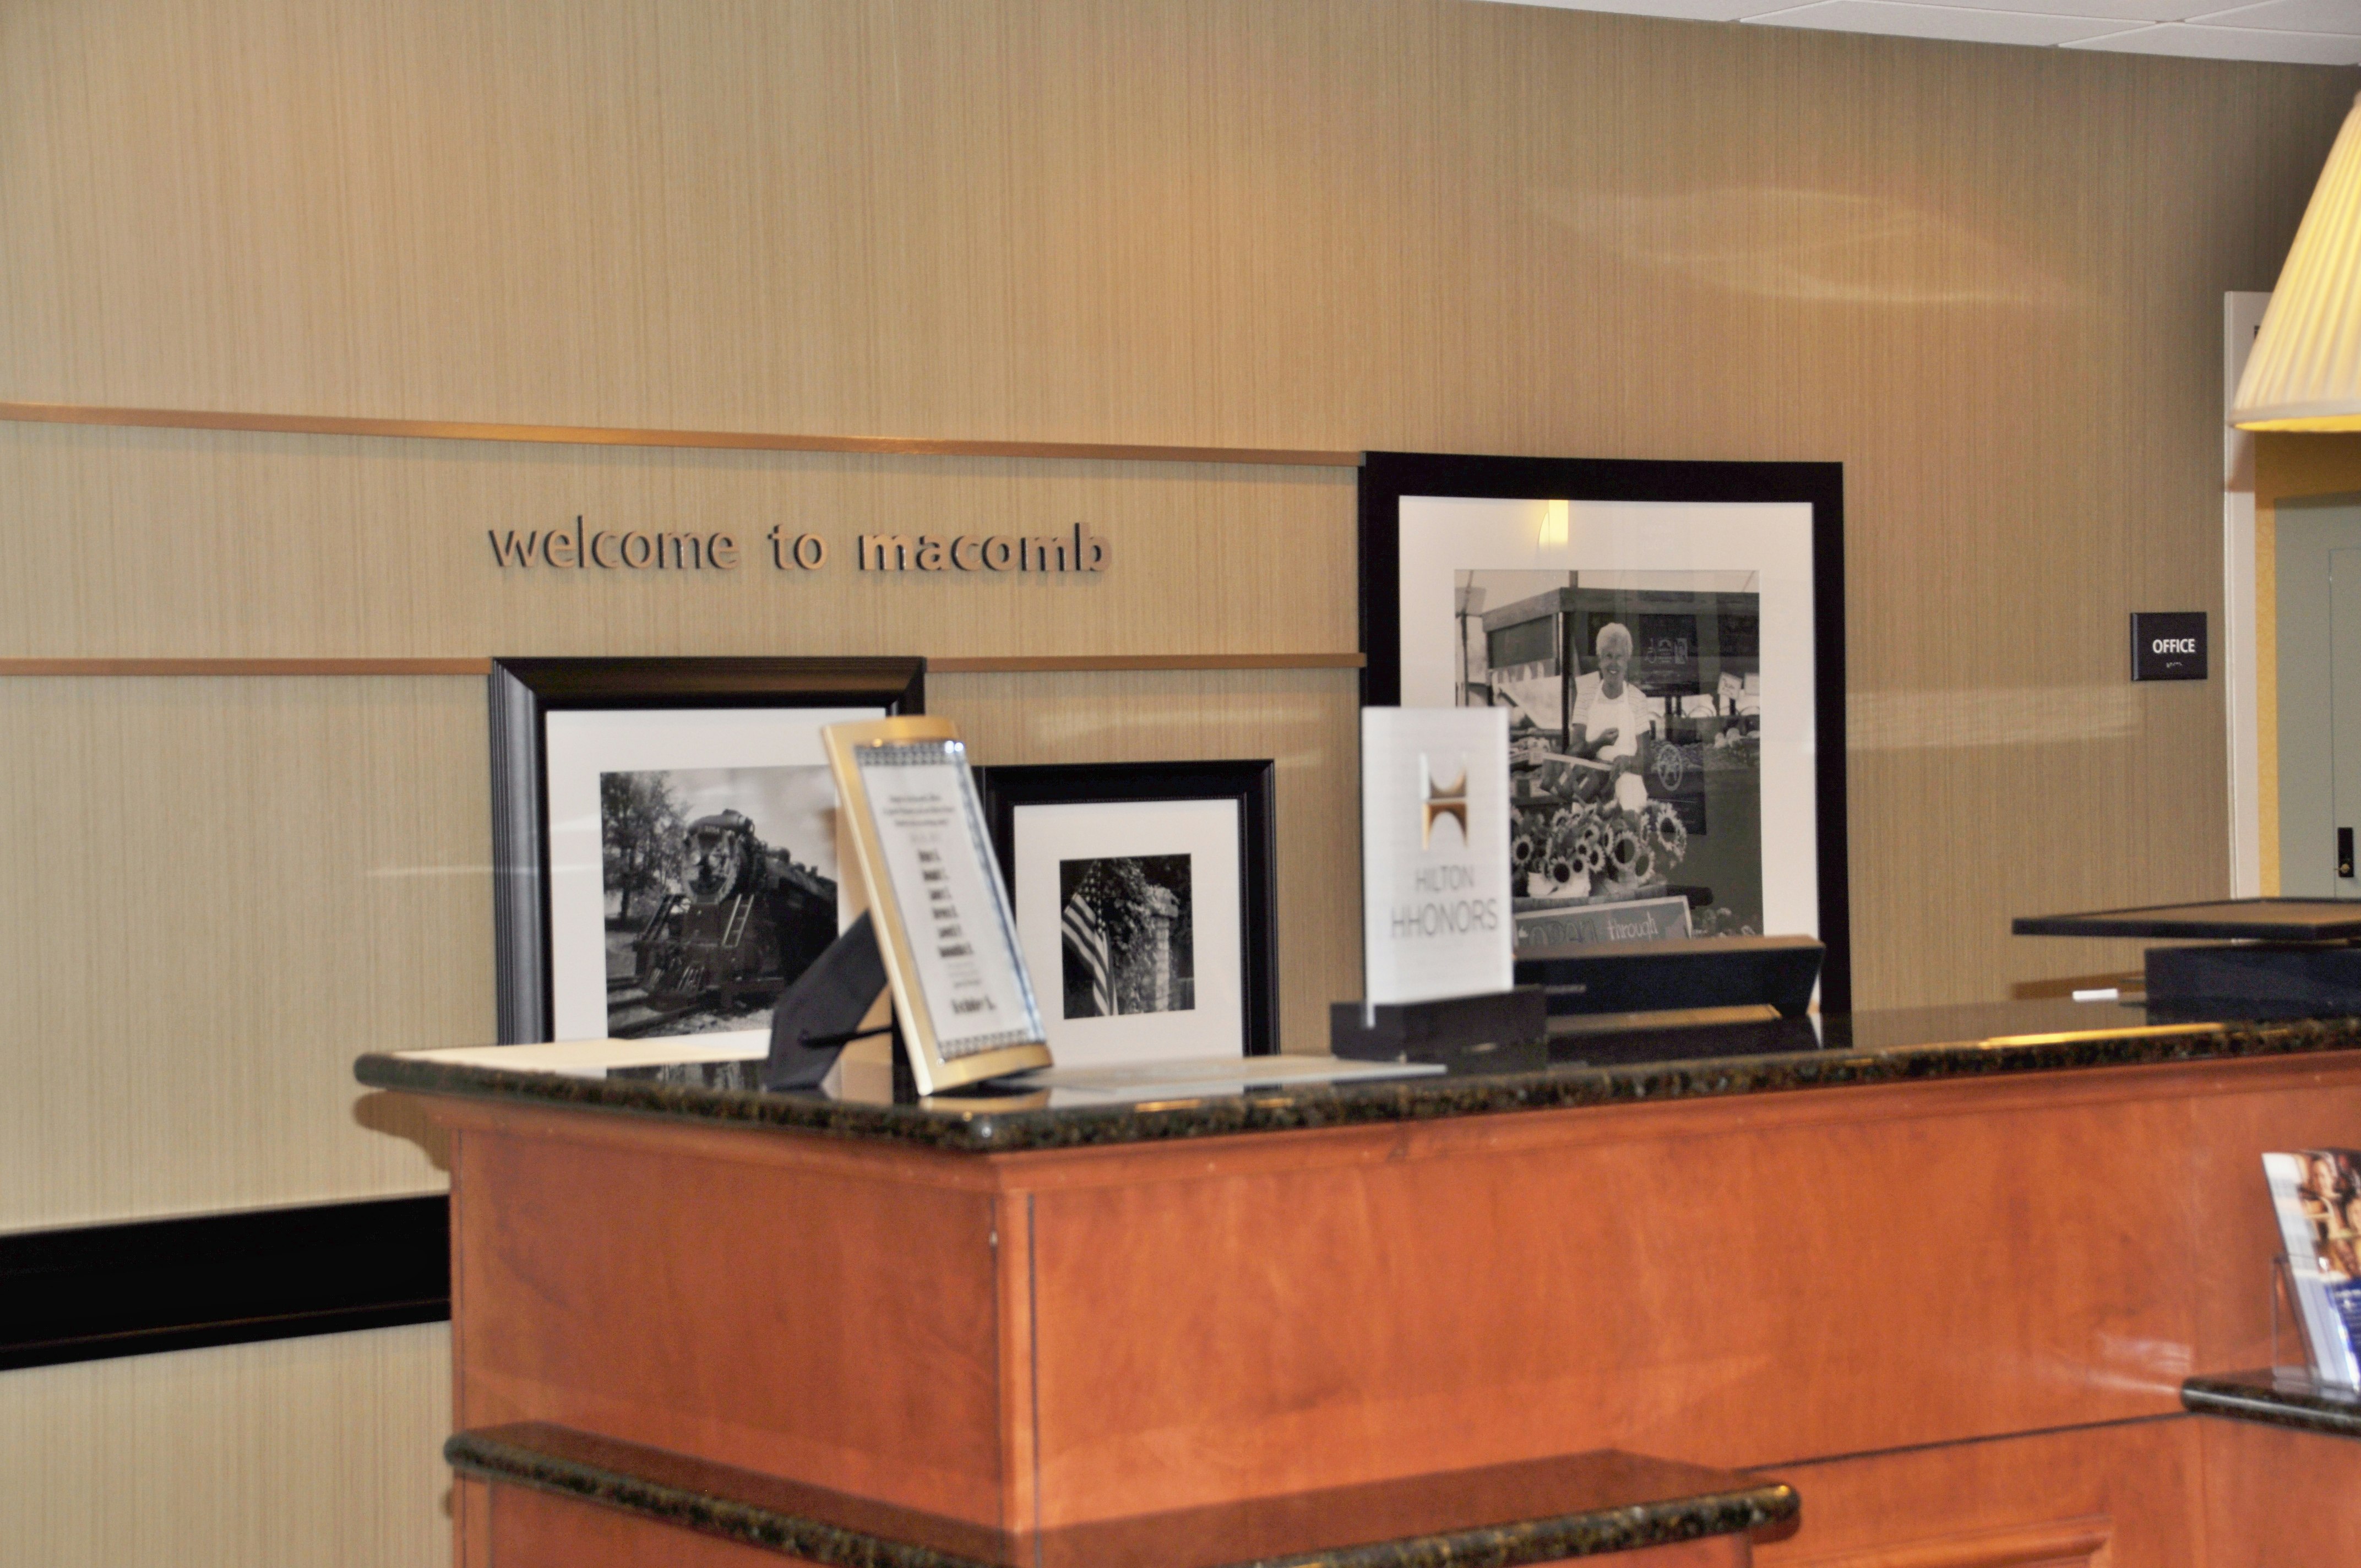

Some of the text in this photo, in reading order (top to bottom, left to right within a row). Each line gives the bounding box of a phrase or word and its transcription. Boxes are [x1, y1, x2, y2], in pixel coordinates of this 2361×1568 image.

[488, 514, 1112, 571] welcome to macomb
[2152, 638, 2195, 654] OFFICE
[1415, 863, 1475, 893] HILTON
[1390, 897, 1498, 938] HHONORS
